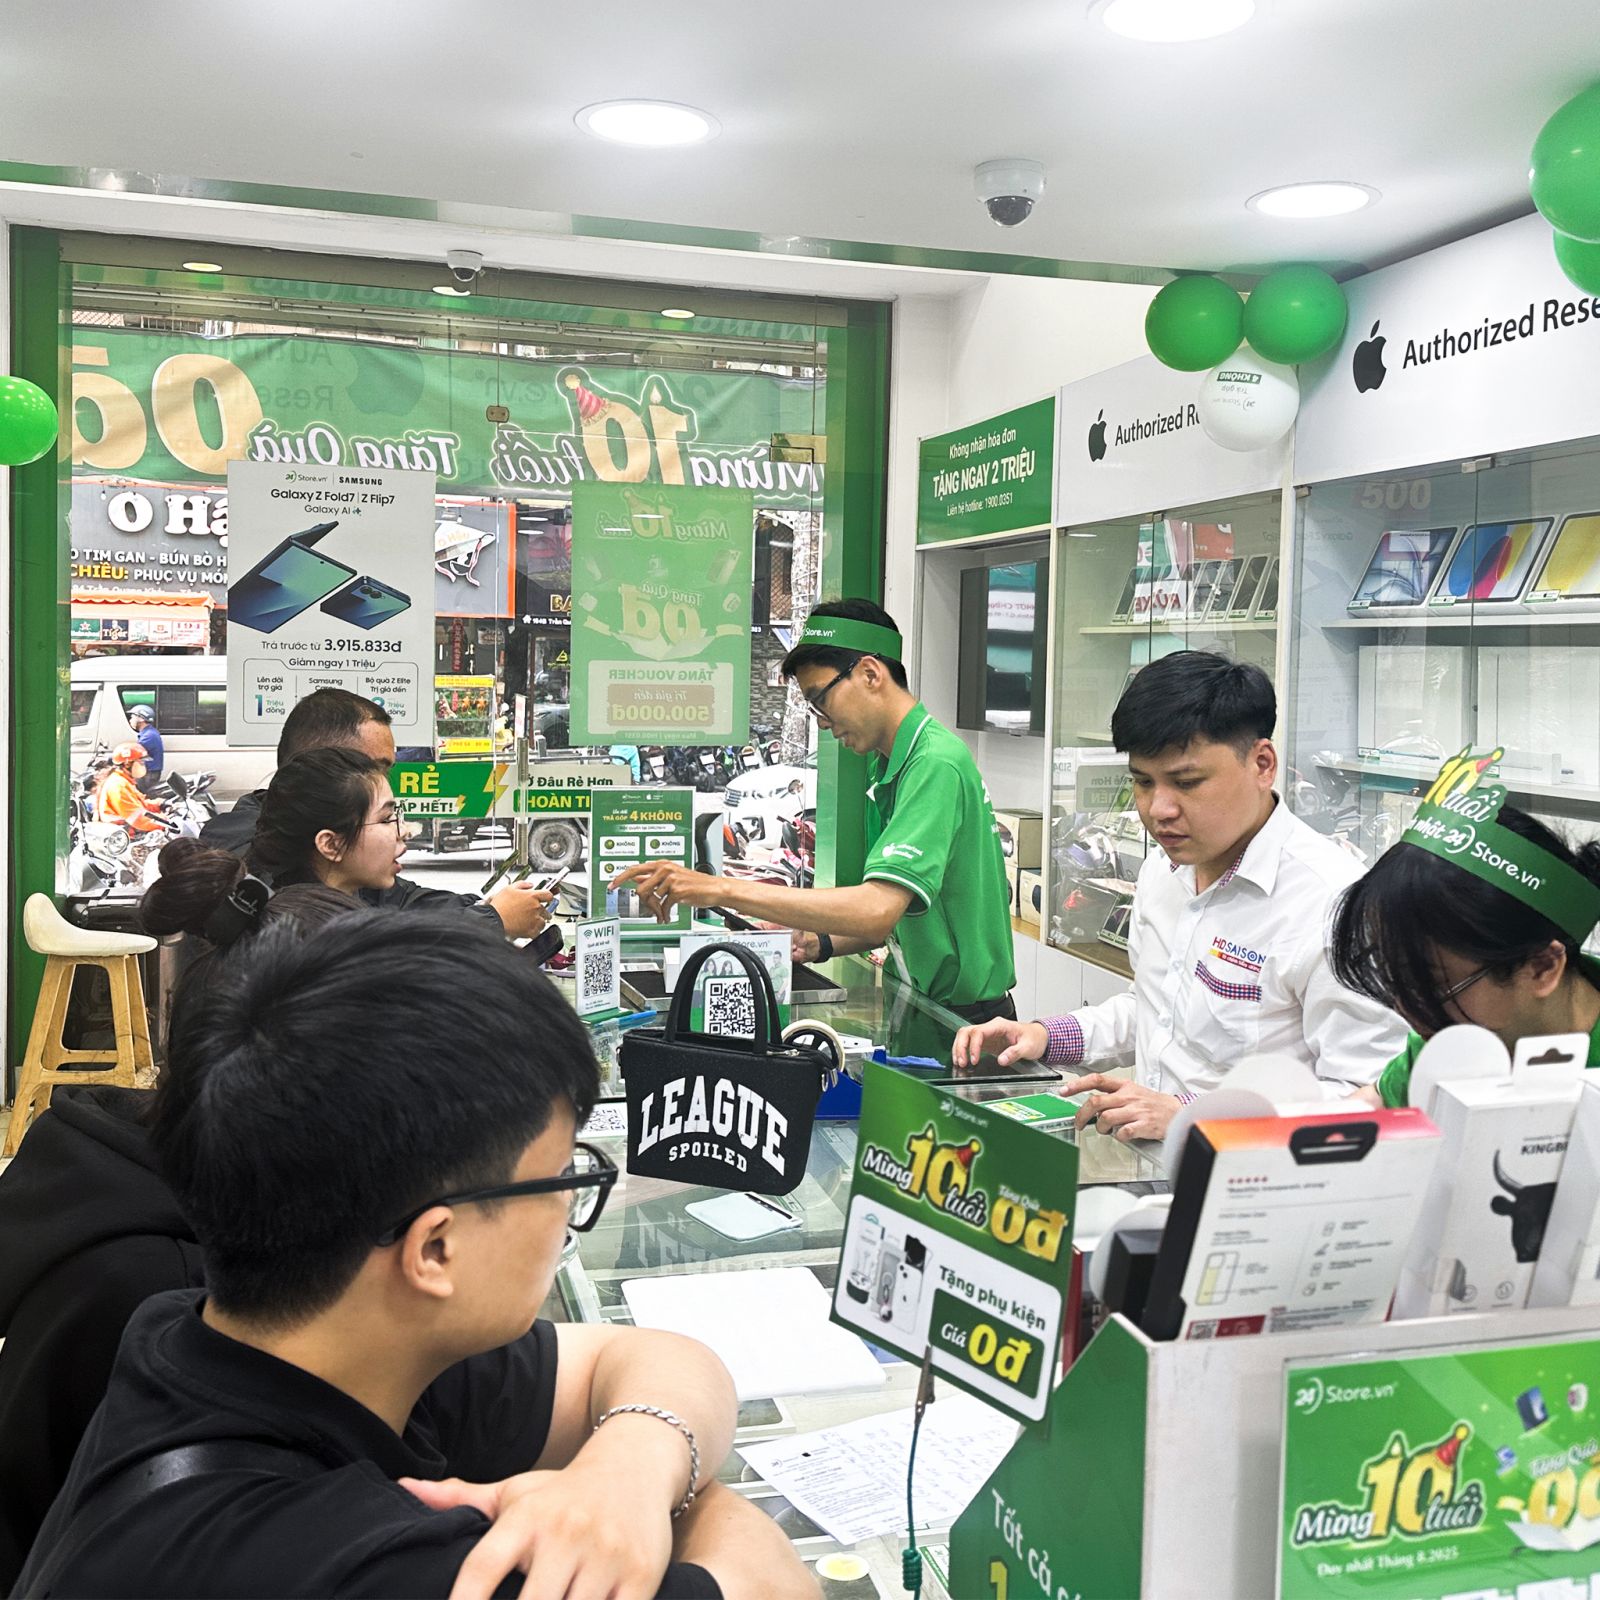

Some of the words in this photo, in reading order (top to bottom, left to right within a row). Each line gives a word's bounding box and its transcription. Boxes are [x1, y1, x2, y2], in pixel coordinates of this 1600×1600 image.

[1402, 304, 1535, 369] Authorized
[1115, 404, 1183, 446] Authorized
[949, 441, 970, 460] Không
[970, 437, 987, 454] nhận
[987, 431, 1001, 447] hóa
[1001, 427, 1017, 443] đơn
[298, 473, 328, 482] Store.vn
[339, 476, 383, 486] SAMSUNG
[933, 468, 960, 501] TẶNG
[961, 463, 991, 491] NGAY
[991, 460, 999, 485] 2
[1001, 446, 1035, 484] TRIỆU
[270, 488, 314, 502] Galaxy
[315, 491, 323, 501] Z
[324, 492, 355, 502] Fold7
[361, 494, 368, 503] Z
[370, 494, 396, 507] Flip7
[304, 505, 339, 516] Galaxy
[83, 549, 112, 562] TIM
[115, 551, 146, 563] GAN
[159, 548, 189, 565] BÚN
[193, 551, 213, 567] BÒ
[134, 569, 173, 585] PHỤC
[177, 571, 197, 586] VỤ
[102, 628, 128, 641] Tiger
[804, 628, 833, 638] Store.vn
[261, 641, 278, 650] Trả
[280, 641, 308, 650] trước
[310, 641, 321, 650] từ
[324, 639, 402, 653] 3.915.833đ
[288, 657, 316, 667] Giảm
[318, 660, 343, 669] ngay
[346, 659, 350, 668] 1
[352, 659, 376, 669] Triệu
[308, 677, 343, 686] Samsung
[255, 694, 263, 716] 1
[399, 765, 440, 794] RẺ
[537, 774, 564, 787] Đâu
[567, 775, 584, 787] Rẻ
[587, 777, 614, 786] Hơn
[420, 798, 453, 813] HẾT!
[629, 810, 639, 821] 4
[640, 809, 683, 821] KHÔNG
[1440, 790, 1501, 823] tuổi
[1471, 841, 1541, 891] Store.vn
[594, 925, 615, 938] WIFI
[637, 1075, 788, 1177] LEAGUE
[668, 1142, 748, 1173] SPOILED
[1520, 1141, 1569, 1156] KINGB
[863, 1148, 914, 1189] Mừng
[909, 1136, 969, 1206] 10
[944, 1187, 985, 1227] tuổi
[990, 1197, 1069, 1263] 0đ
[939, 1265, 975, 1297] Tặng
[978, 1287, 1009, 1316] phụ
[1011, 1300, 1046, 1331] kiện
[941, 1322, 967, 1348] Giá
[968, 1324, 1032, 1383] 0đ
[1326, 1381, 1394, 1404] Store.vn
[1296, 1507, 1377, 1541] Mừng
[1366, 1450, 1454, 1537] 10
[1425, 1483, 1481, 1530] tuổi
[991, 1487, 1023, 1560] Tất
[1028, 1547, 1051, 1597] cả
[1378, 1552, 1413, 1569] Tháng
